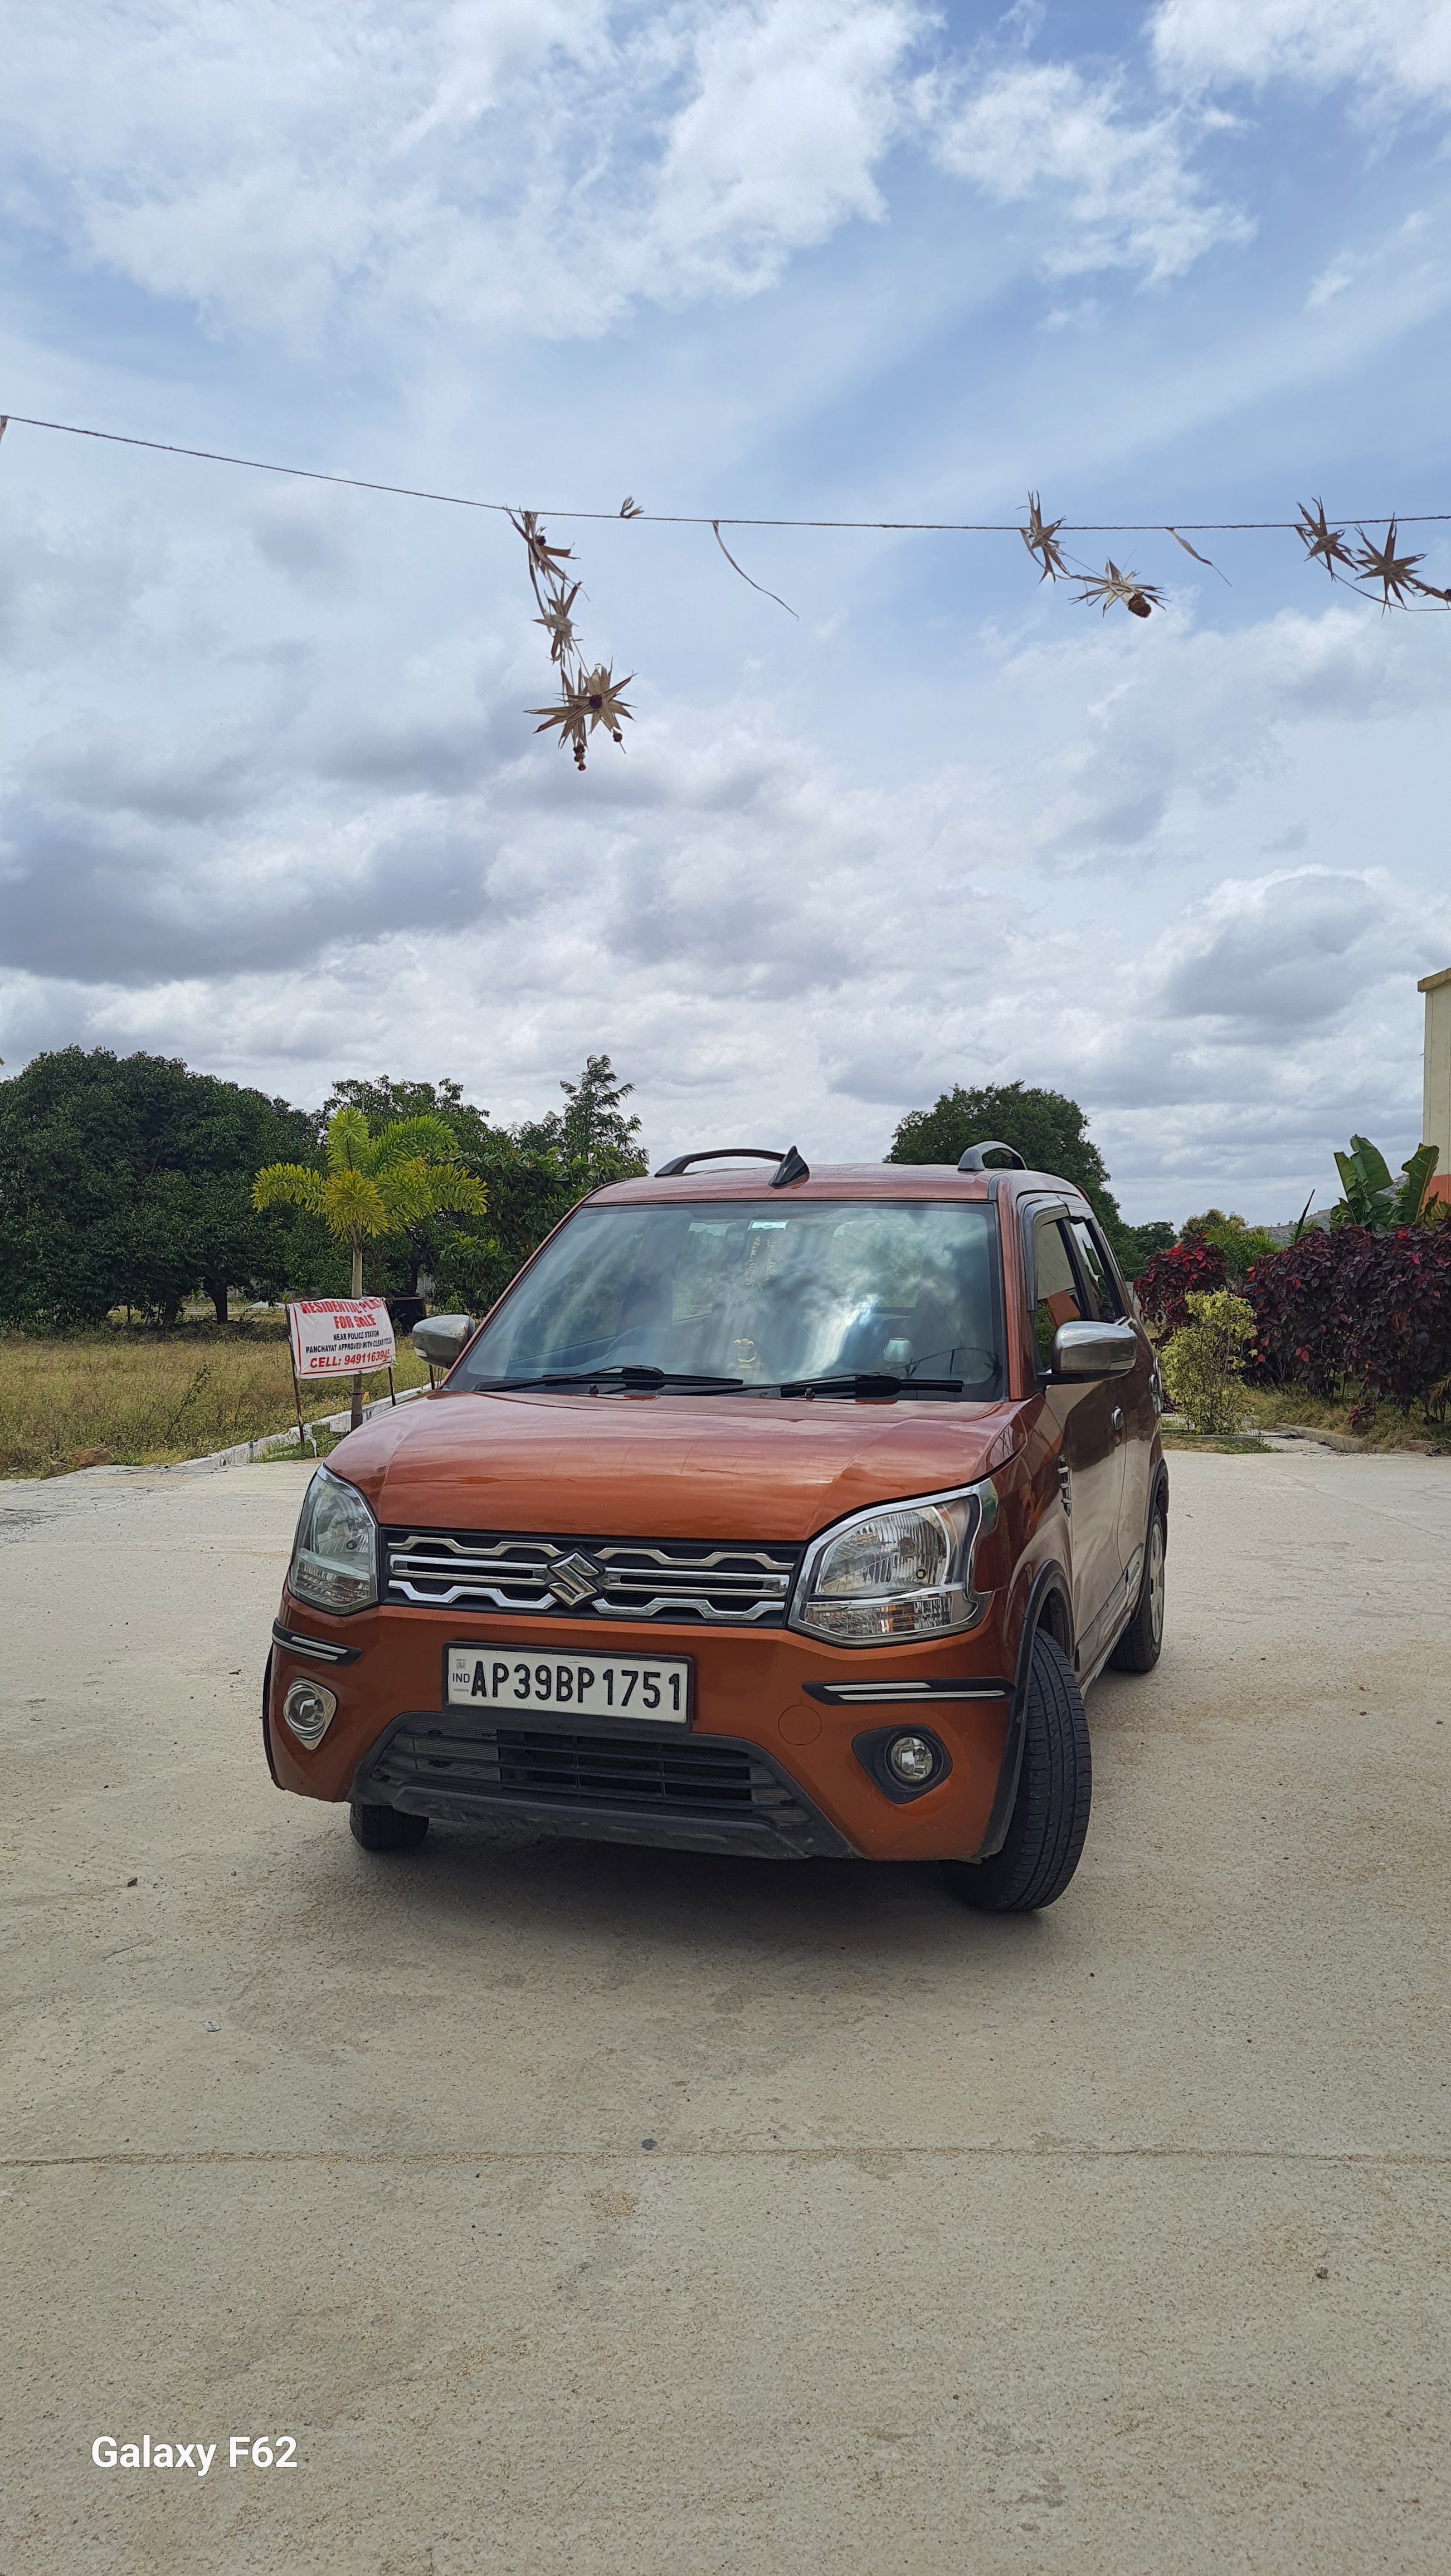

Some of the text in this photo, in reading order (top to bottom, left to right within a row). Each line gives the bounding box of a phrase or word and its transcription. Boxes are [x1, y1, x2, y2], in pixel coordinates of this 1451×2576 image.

[300, 1301, 362, 1314] RESIDENTIAL
[334, 1314, 376, 1329] FOR SALE
[348, 1331, 364, 1340] POLICE
[365, 1330, 379, 1338] STATION
[306, 1344, 337, 1354] PANCHAYAT
[338, 1342, 362, 1351] APPROVED
[310, 1356, 342, 1368] CELL:
[452, 1672, 470, 1683] IND
[471, 1661, 680, 1711] AP39BP1751
